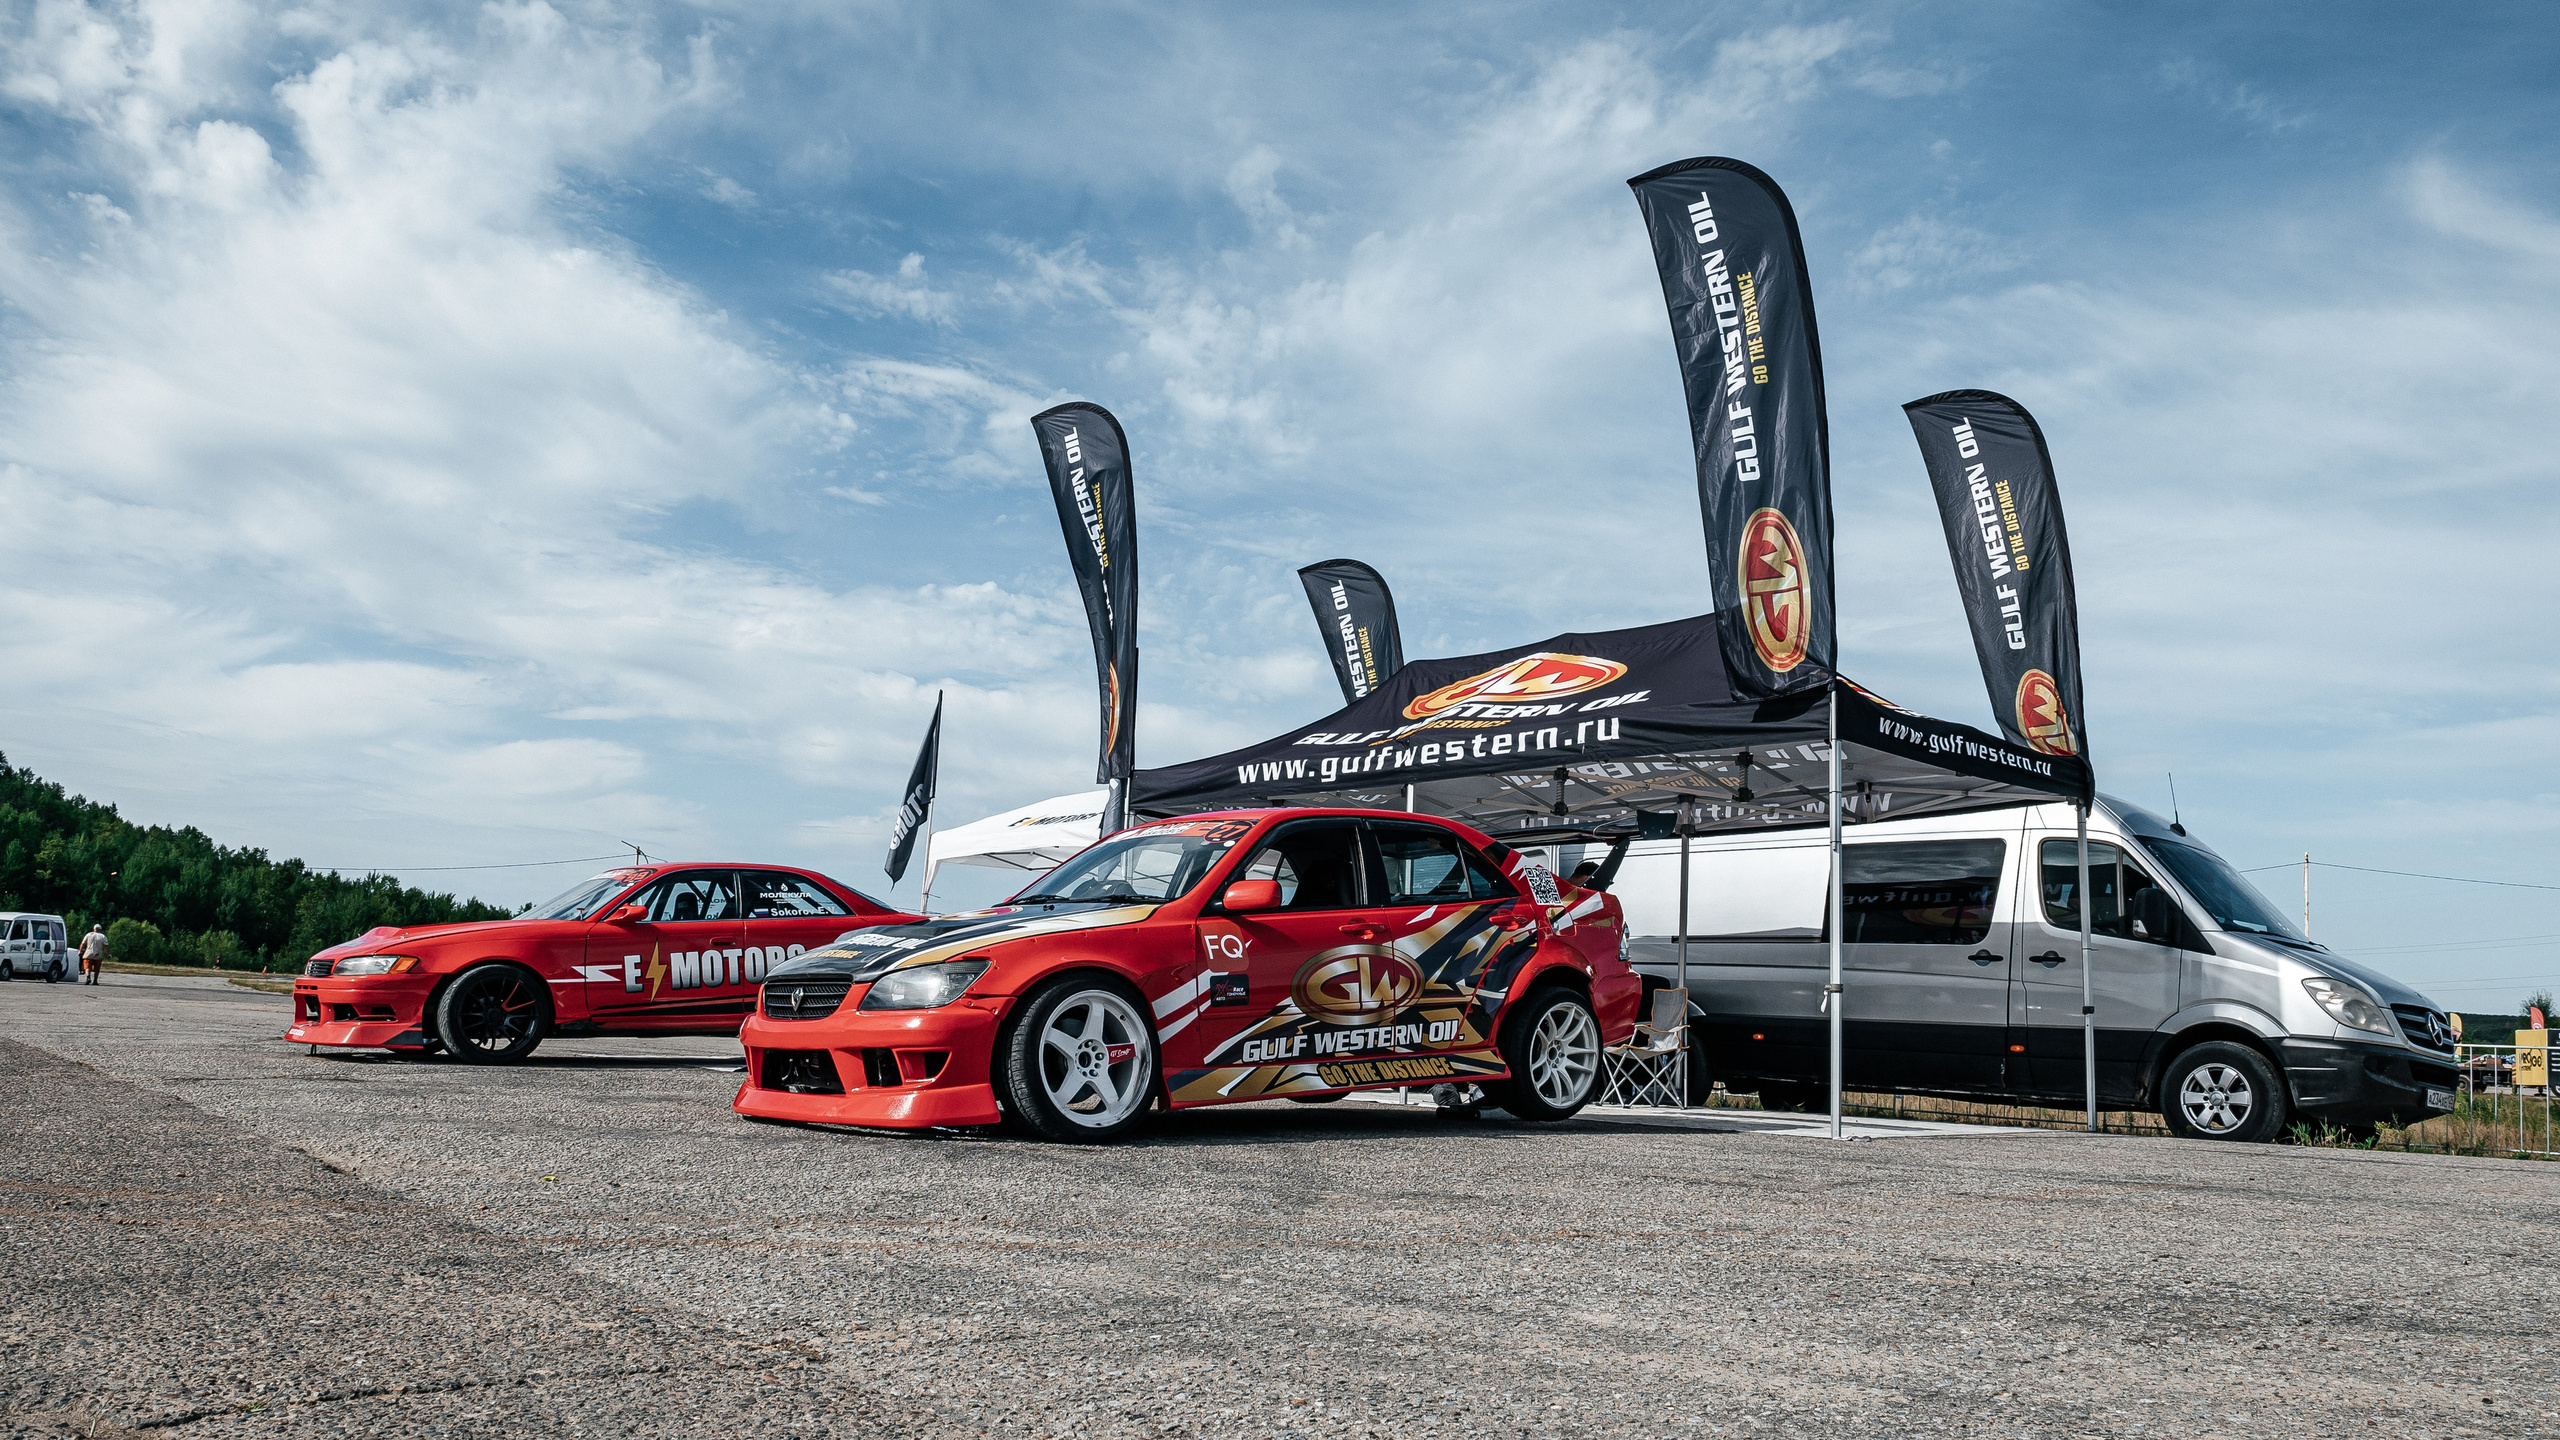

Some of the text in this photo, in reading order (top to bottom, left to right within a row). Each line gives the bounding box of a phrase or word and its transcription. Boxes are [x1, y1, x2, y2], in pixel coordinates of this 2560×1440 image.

[1687, 191, 1761, 482] GULF WESTERN OIL
[1736, 270, 1769, 385] GO THE DISTANCE
[1063, 426, 1082, 464] OIL
[1952, 416, 2027, 650] GULF WESTERN OIL
[1994, 479, 2030, 572] GO THE DISTANCE
[1330, 579, 1349, 611] OIL
[1357, 626, 1374, 668] DISTANCE
[1366, 667, 1378, 685] THE
[1291, 729, 1391, 746] GULF
[1387, 702, 1579, 739] WSTERN
[1577, 689, 1652, 713] OIL
[1237, 716, 1620, 784] www.gulfwestern.ru
[1878, 716, 2052, 777] www.gulfwestern.ru
[1209, 823, 1250, 839] 27
[770, 907, 816, 917] Sokorov
[1203, 934, 1243, 959] FQ
[623, 953, 645, 993] E
[1303, 954, 1414, 1013] GW
[1242, 1019, 1465, 1063] GULF WESTERN OIL
[1318, 1056, 1455, 1086] GO THE DISTANCE
